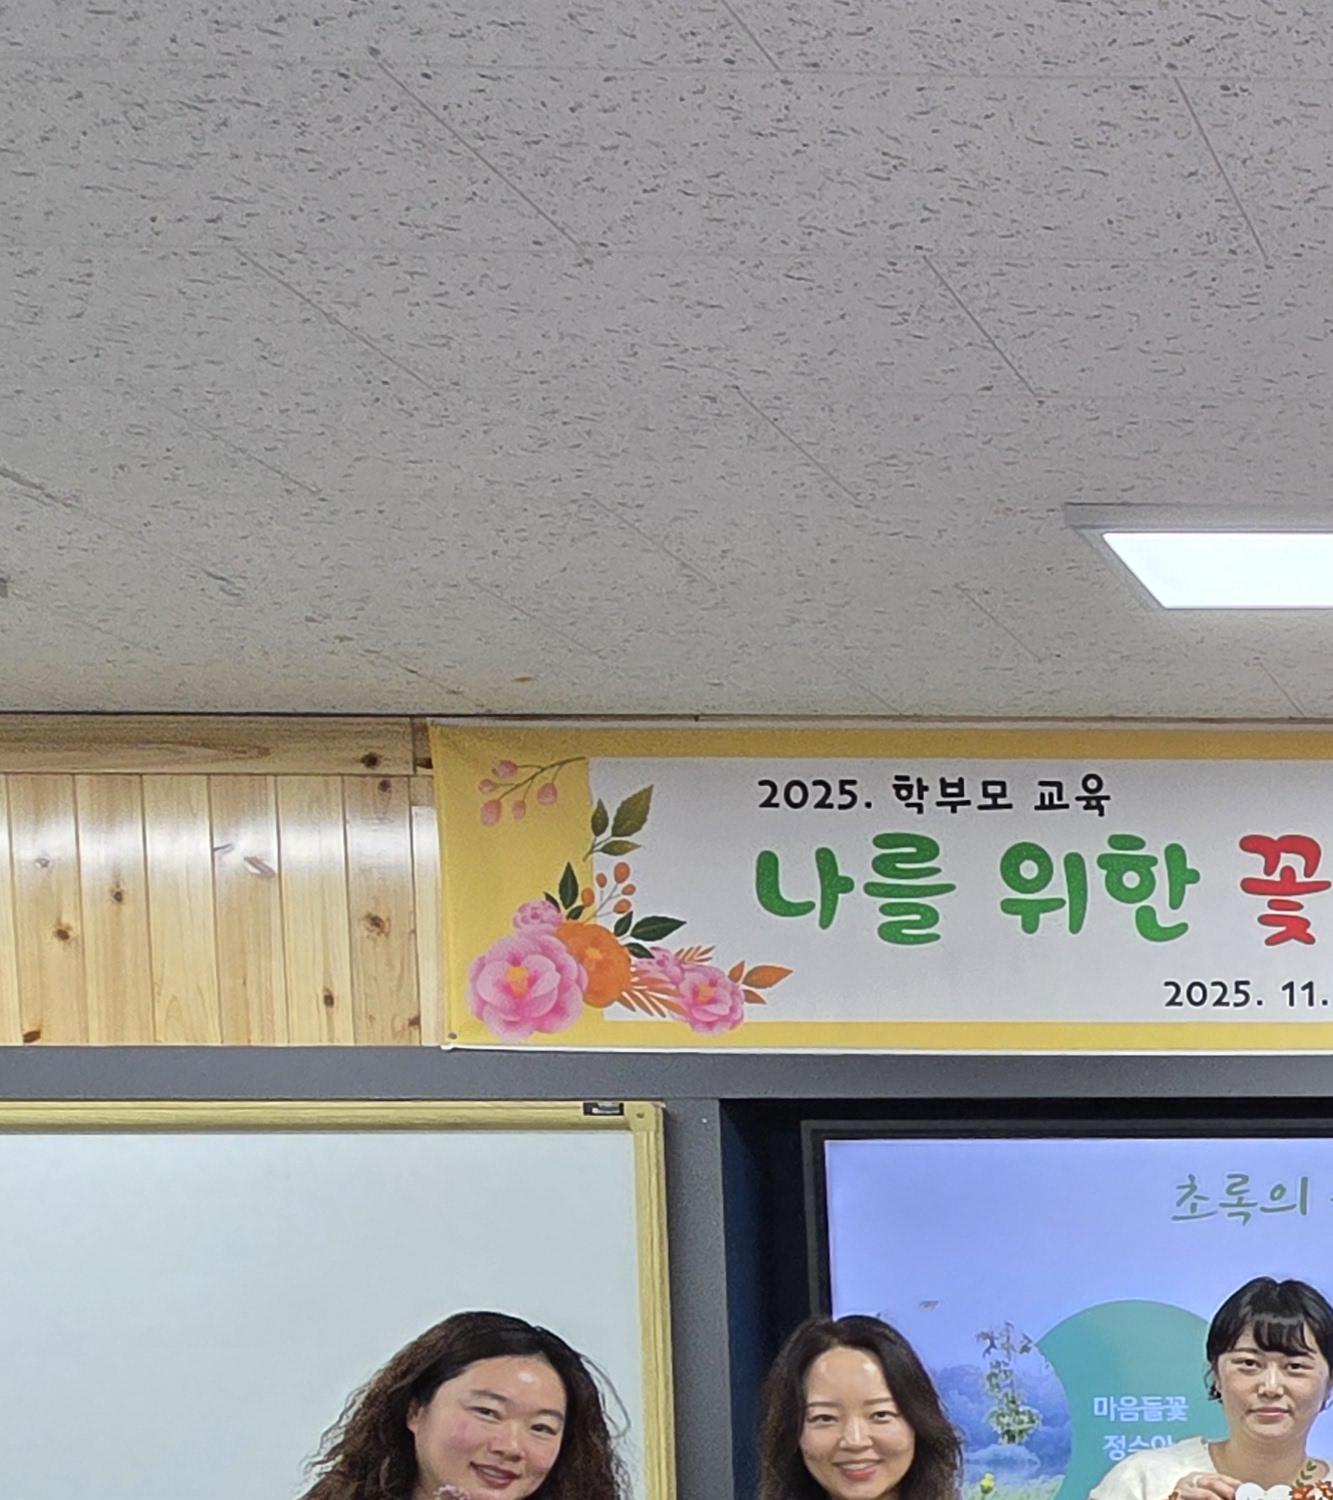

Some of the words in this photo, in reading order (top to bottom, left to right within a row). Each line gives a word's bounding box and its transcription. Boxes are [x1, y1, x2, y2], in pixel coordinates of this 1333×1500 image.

[757, 778, 873, 811] 2025.
[891, 773, 1014, 815] 학부모
[1033, 773, 1111, 818] 교육
[756, 832, 955, 945] 나를
[1000, 834, 1200, 941] 위한
[1164, 980, 1264, 1008] 2025.
[1281, 981, 1328, 1007] 11.
[1171, 1173, 1309, 1226] 초록의
[1093, 1395, 1189, 1422] 마음들꽃
